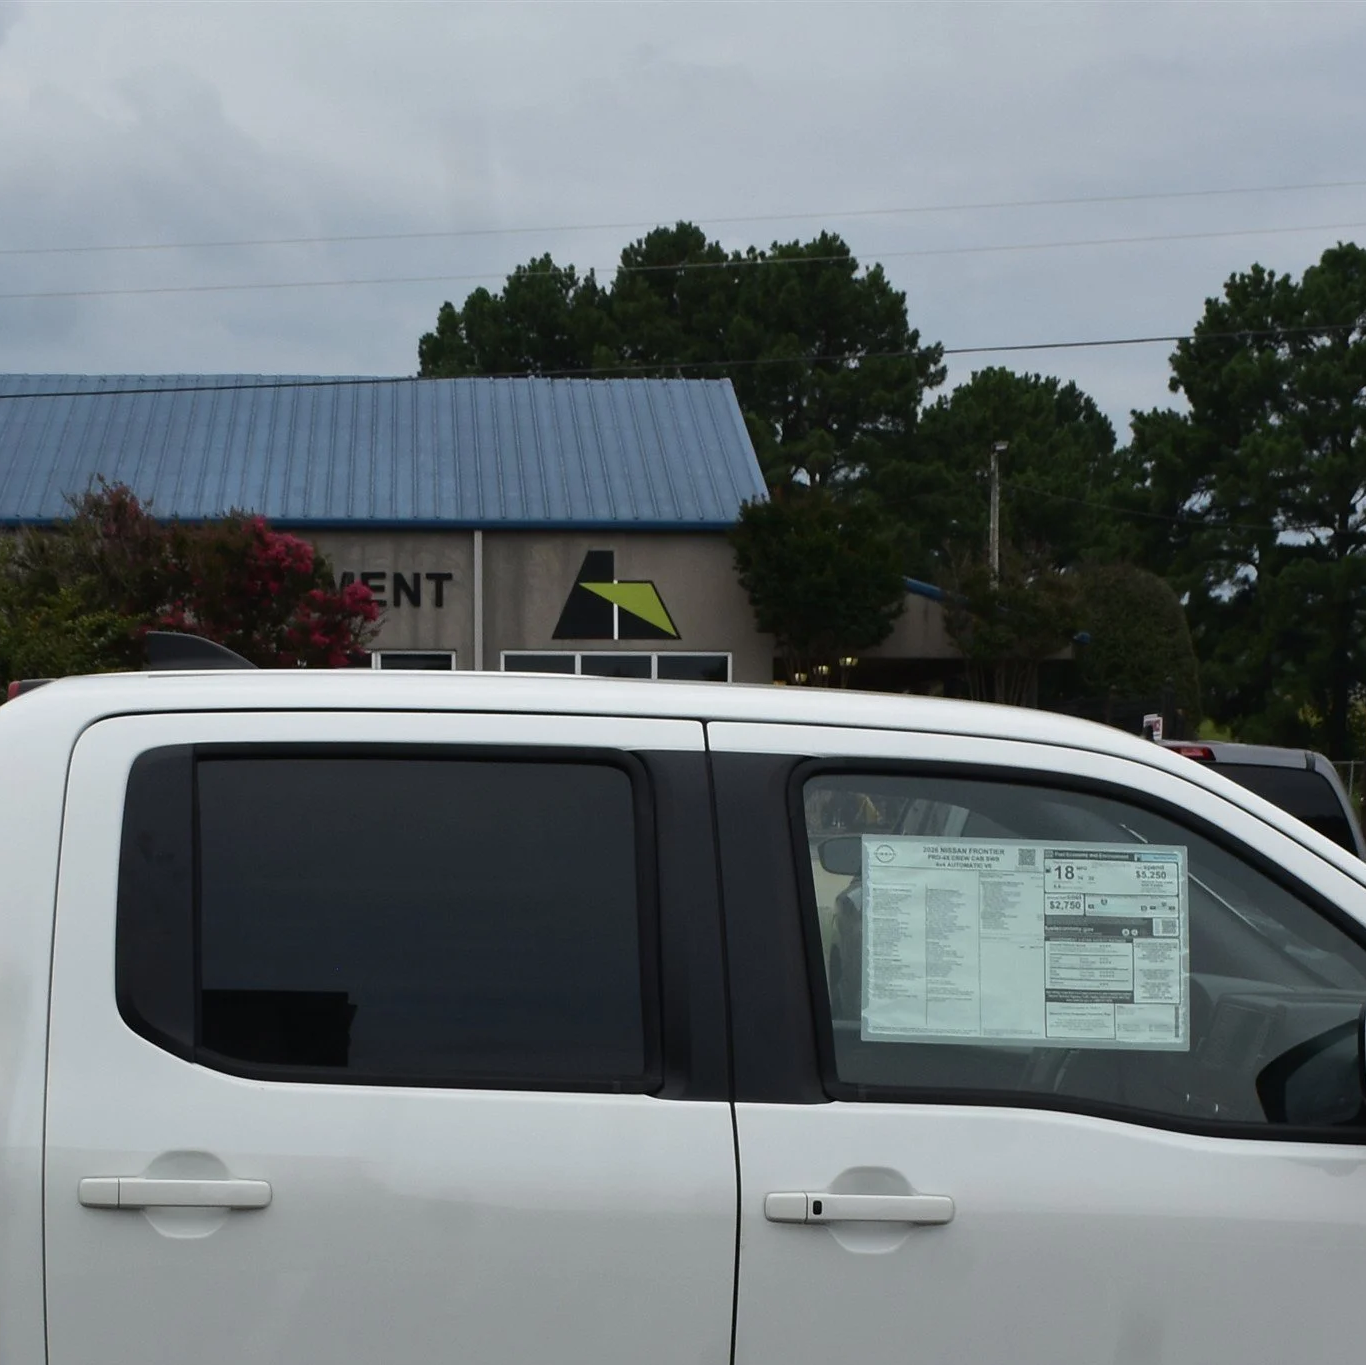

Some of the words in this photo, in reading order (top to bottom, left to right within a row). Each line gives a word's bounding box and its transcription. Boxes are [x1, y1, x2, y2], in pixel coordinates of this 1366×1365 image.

[940, 847, 967, 855] NISSAN
[1055, 865, 1075, 880] 18
[1050, 901, 1081, 910] $2,750
